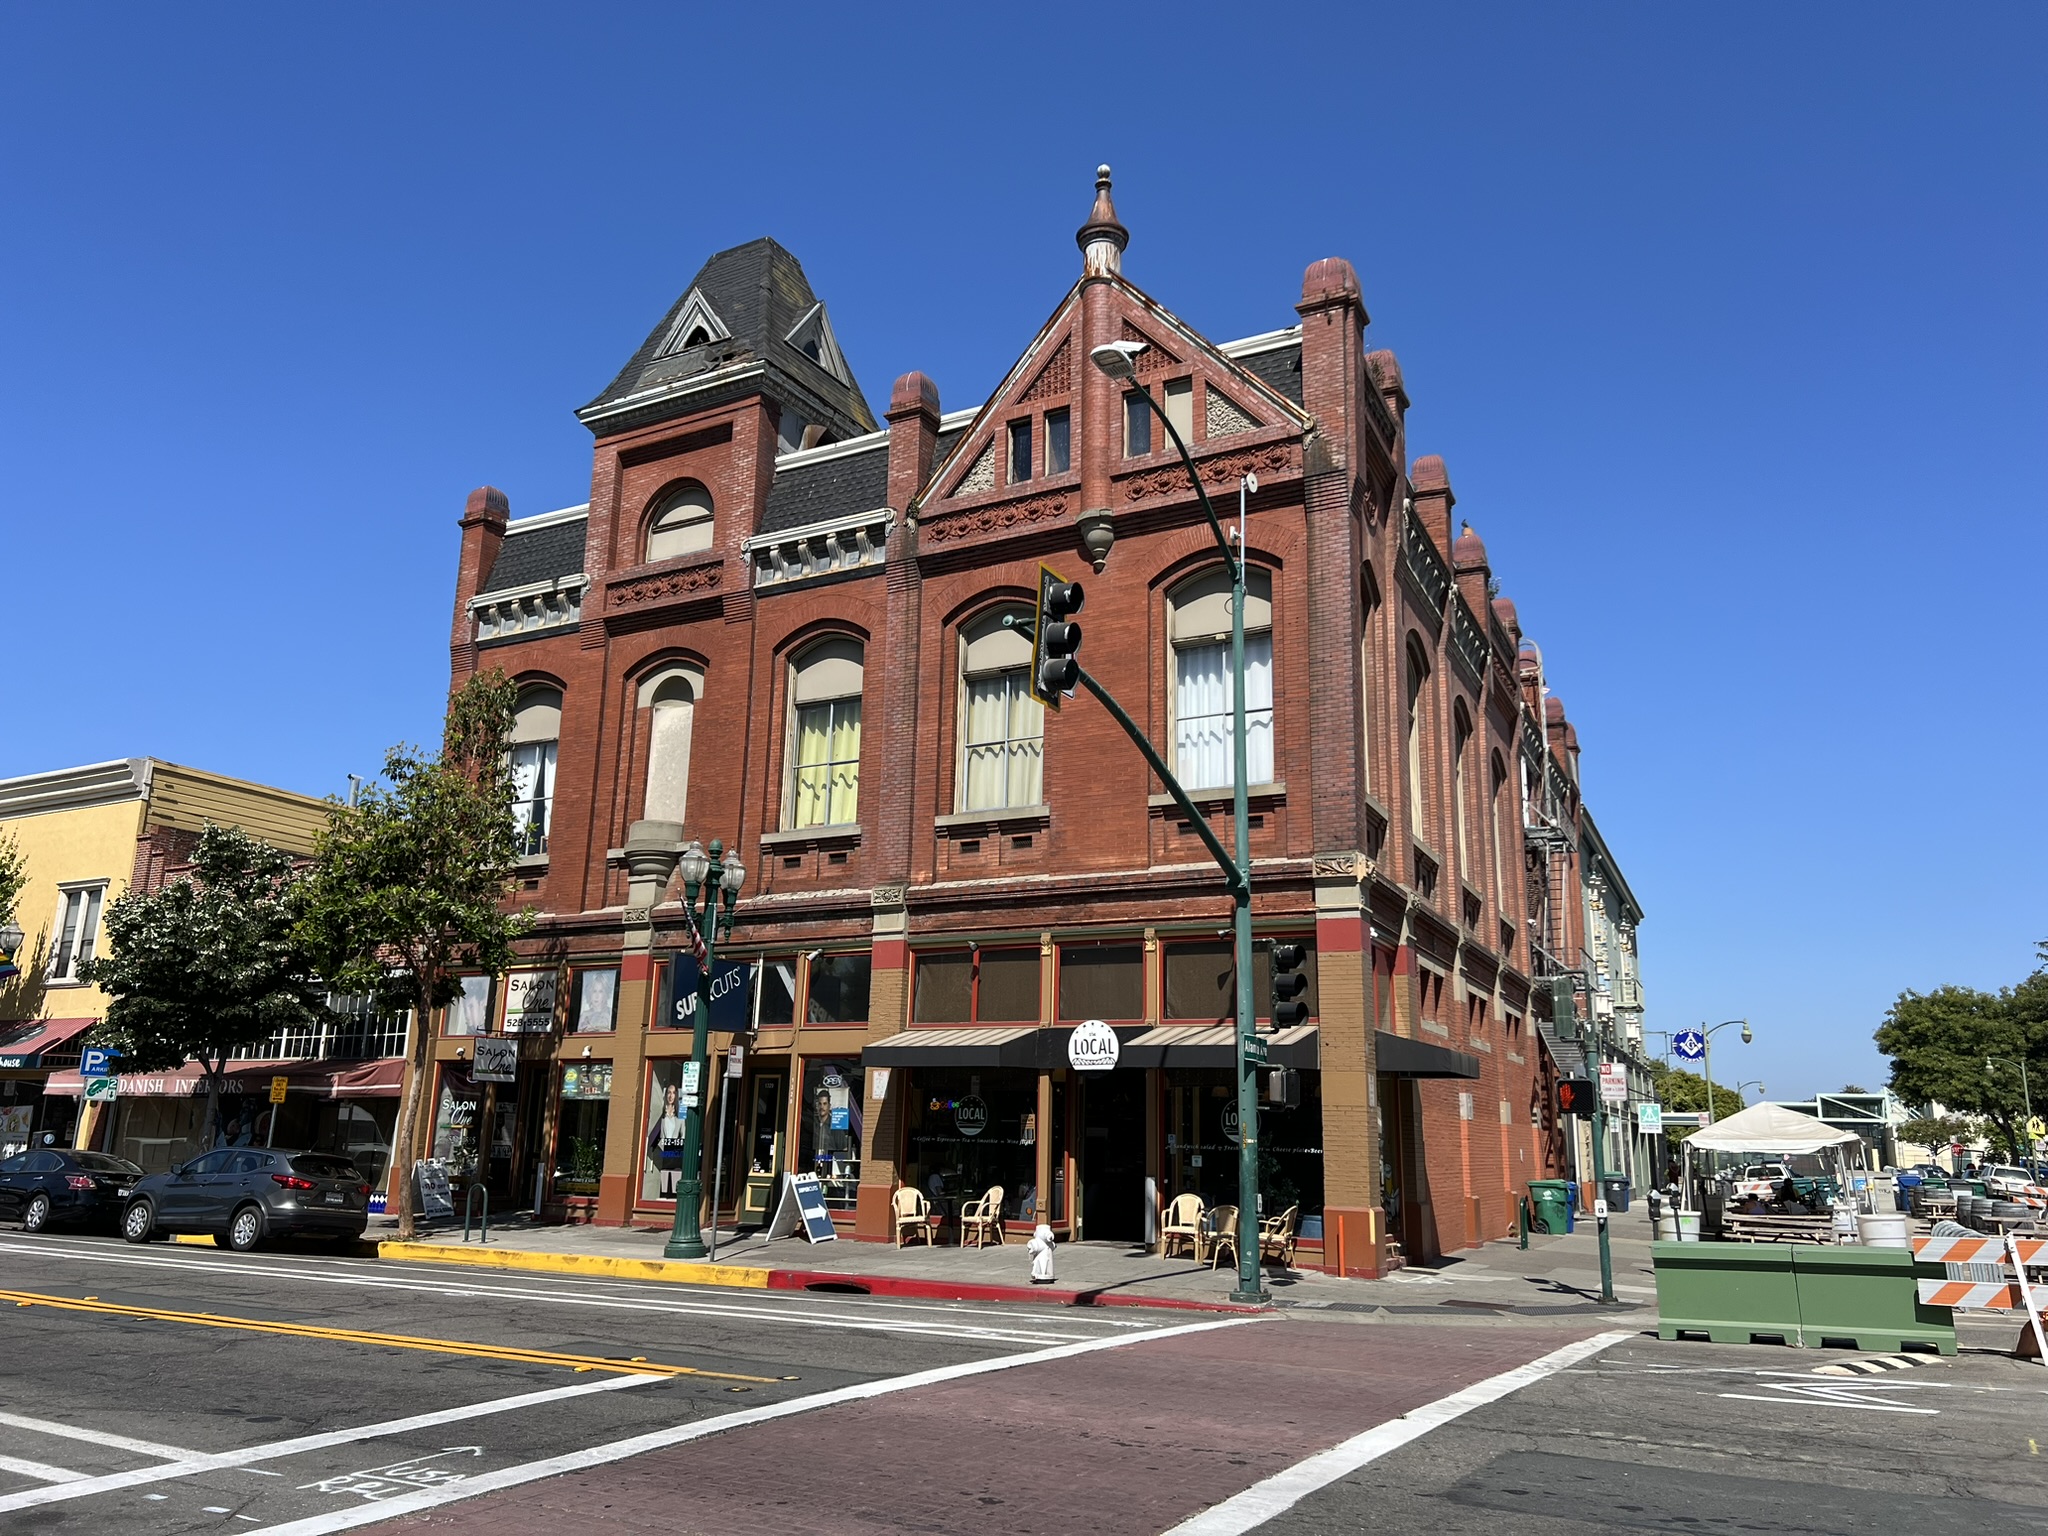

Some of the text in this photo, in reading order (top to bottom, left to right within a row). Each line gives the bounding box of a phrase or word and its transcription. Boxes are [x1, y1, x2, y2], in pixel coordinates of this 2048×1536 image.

[510, 979, 555, 991] SALON
[522, 984, 549, 1009] One
[676, 967, 741, 1020] SUPCUTS
[477, 1046, 516, 1057] SALON
[1074, 1038, 1114, 1055] LOCAL
[488, 1051, 511, 1071] One
[1601, 1065, 1610, 1074] NO
[110, 1079, 117, 1088] 2
[119, 1079, 244, 1094] DANISH INTERORS
[442, 1099, 477, 1111] SALON
[451, 1106, 473, 1125] One
[958, 1108, 985, 1120] LOCAL
